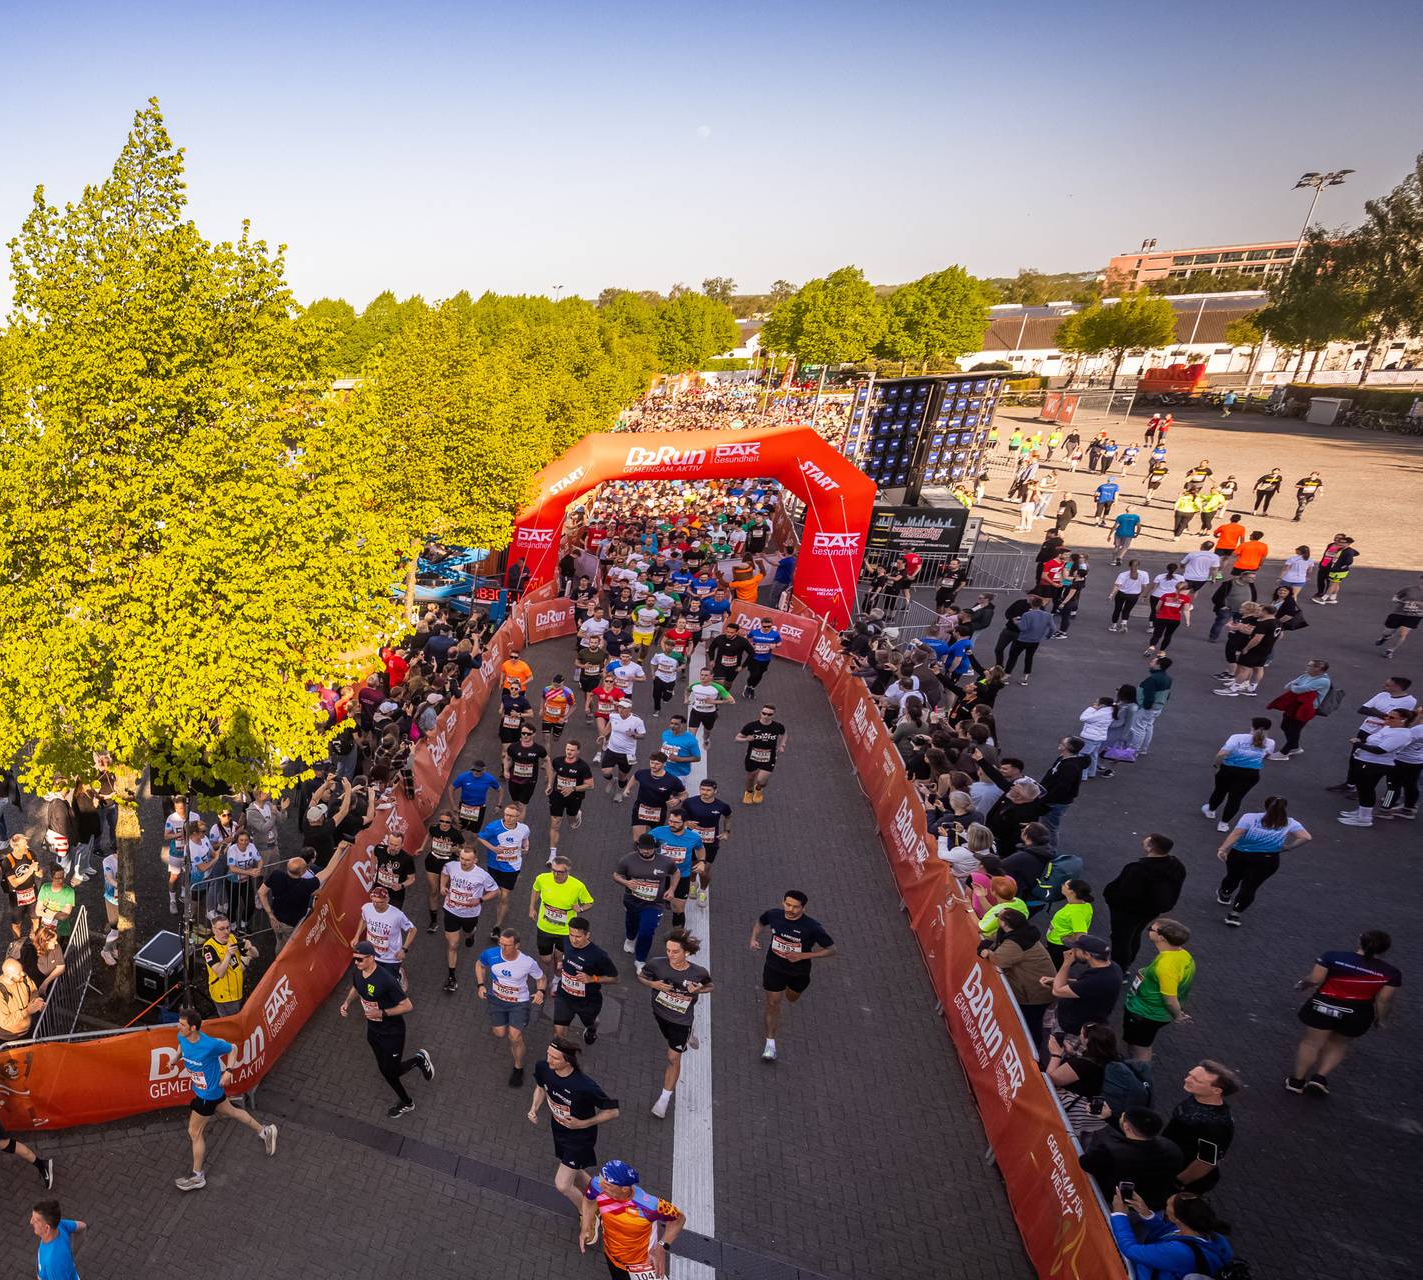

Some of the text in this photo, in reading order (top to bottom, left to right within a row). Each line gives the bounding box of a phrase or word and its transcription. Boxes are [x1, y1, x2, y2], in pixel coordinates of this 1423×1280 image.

[625, 442, 761, 466] B2Run DAK
[714, 455, 760, 464] Gesundheit
[549, 466, 585, 496] START
[799, 460, 840, 492] START
[517, 528, 553, 542] DAK
[813, 532, 861, 548] DAK
[812, 546, 858, 556] Gesundheit
[264, 974, 294, 1025] DAK
[271, 995, 298, 1040] Gesundheit
[961, 961, 1025, 1099] B2Run DAK
[238, 1052, 266, 1082] AKTIV
